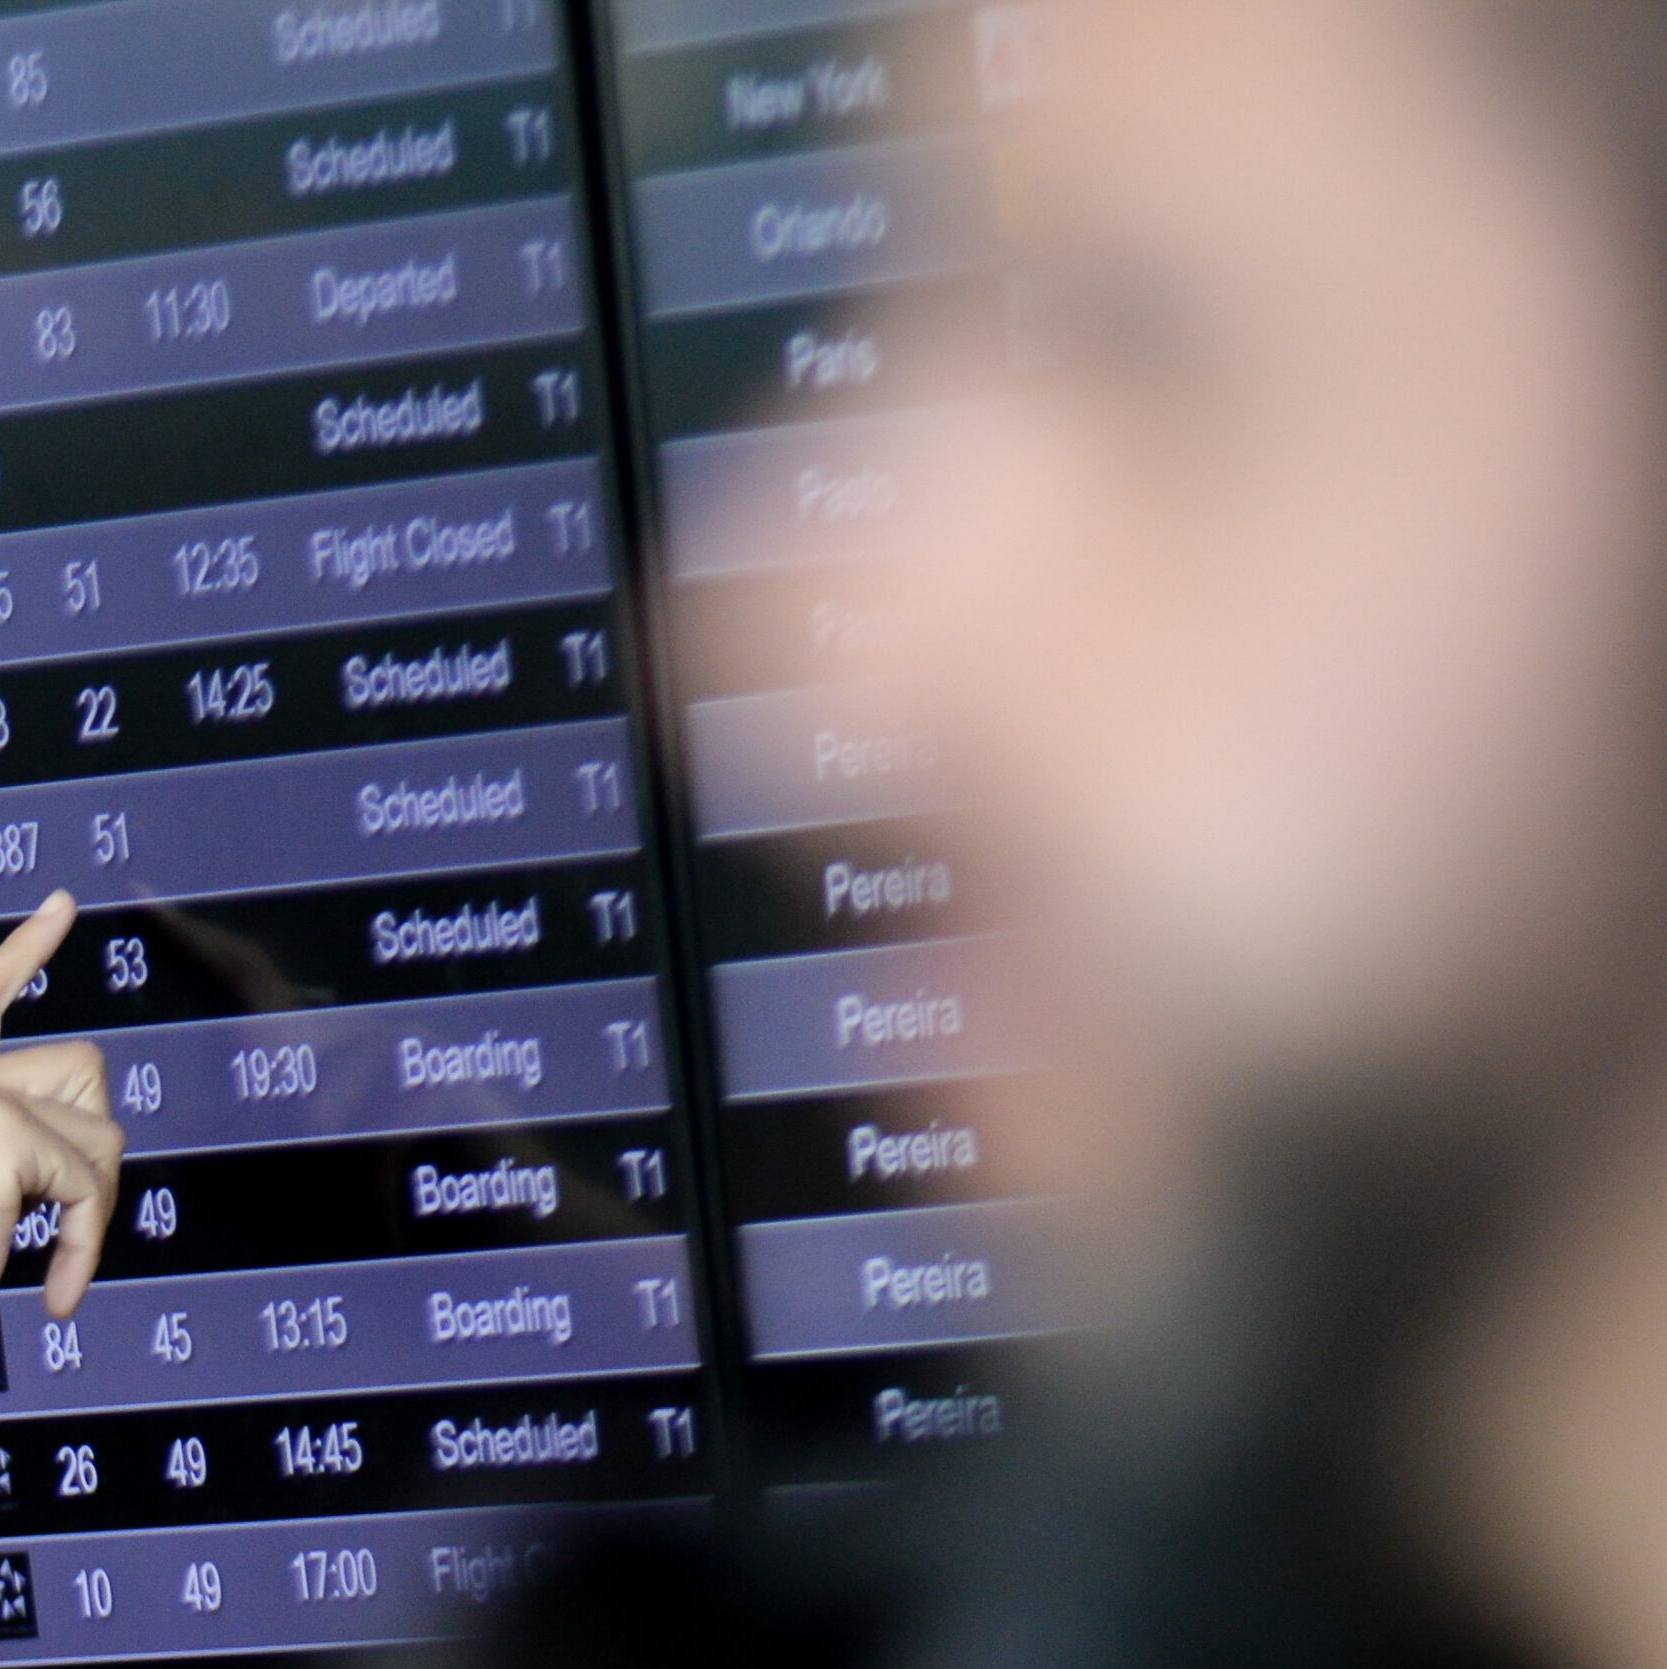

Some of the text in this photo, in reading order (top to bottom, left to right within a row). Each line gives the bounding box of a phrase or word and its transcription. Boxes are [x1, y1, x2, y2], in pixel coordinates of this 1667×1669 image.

[9, 51, 48, 108] 85
[274, 0, 439, 66] Scheduled
[286, 114, 455, 198] Scheduled
[505, 106, 552, 165] T1
[35, 305, 75, 362] 83
[147, 278, 231, 341] 11:30
[311, 250, 457, 328] Departed
[521, 239, 564, 295] T1
[315, 376, 484, 453] Scheduled
[533, 368, 581, 429] T1
[65, 558, 101, 617] 51
[175, 534, 259, 596] 12:35
[311, 531, 398, 591] Flight
[406, 508, 514, 570] Closed
[548, 501, 591, 552] T1
[77, 685, 119, 744] 22
[188, 661, 274, 724] 14:25
[341, 639, 512, 712] Scheduled
[562, 630, 605, 686] T1
[92, 811, 129, 866] 51
[359, 768, 526, 836] Scheduled
[579, 761, 619, 813] T1
[823, 859, 952, 922] Pereira
[106, 936, 148, 992] 53
[372, 898, 541, 966] Scheduled
[590, 891, 636, 947] T1
[837, 990, 962, 1051] Pereira
[124, 1062, 162, 1114] 49
[231, 1044, 317, 1100] 19:30
[398, 1030, 542, 1090] Boarding
[605, 1021, 649, 1072] T1
[138, 1187, 177, 1240] 49
[414, 1156, 557, 1219] Boarding
[619, 1149, 665, 1201] T1
[847, 1121, 978, 1184] Pereira
[44, 1321, 83, 1373] 84
[153, 1311, 192, 1364] 45
[264, 1296, 348, 1353] 13:15
[429, 1284, 571, 1345] Boarding
[637, 1278, 680, 1329] T1
[862, 1253, 990, 1309] Pereira
[57, 1407, 695, 1498] 26 49 14:45 Scheduled T1
[873, 1384, 1002, 1445] Pereira
[76, 1568, 112, 1617] 10
[184, 1560, 221, 1613] 49
[292, 1547, 377, 1602] 17:00
